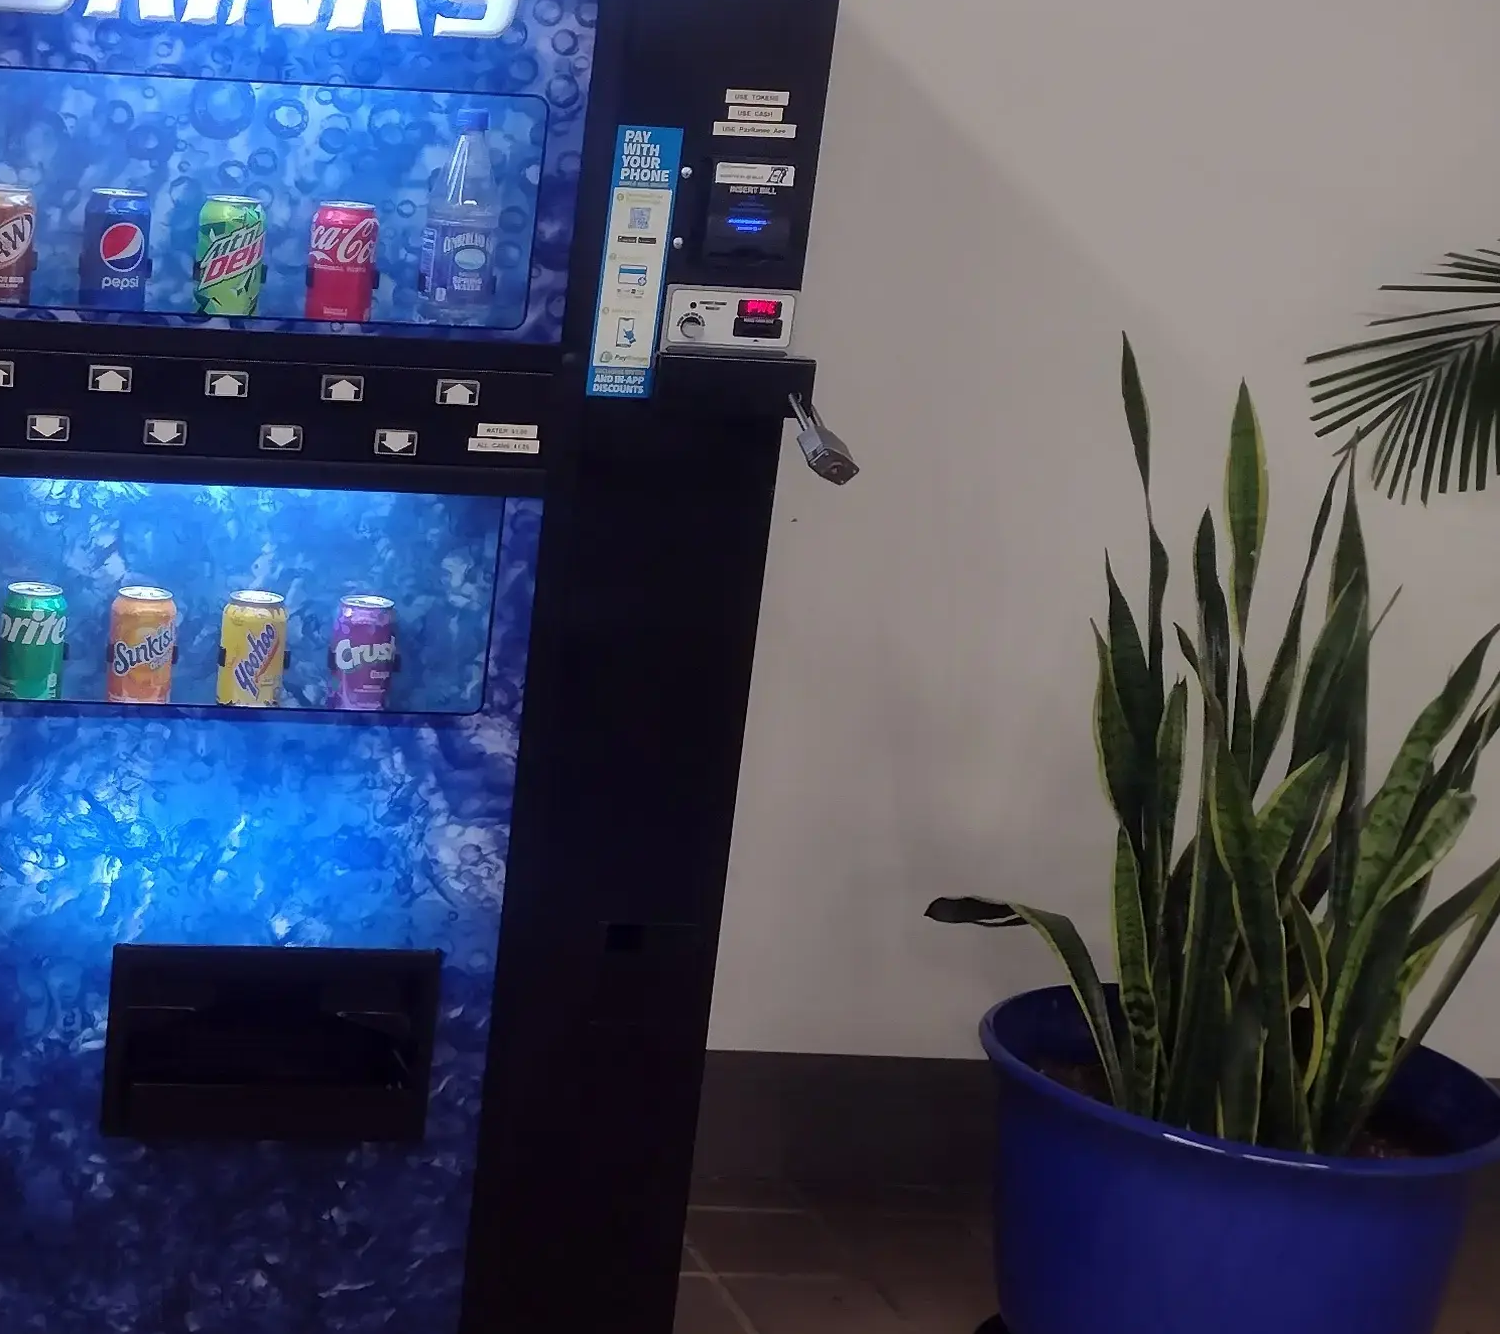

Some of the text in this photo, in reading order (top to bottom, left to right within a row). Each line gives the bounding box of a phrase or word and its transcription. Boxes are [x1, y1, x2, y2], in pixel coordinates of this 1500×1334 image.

[625, 130, 652, 143] PAY
[623, 142, 660, 157] WITH
[621, 155, 660, 169] YOUR
[620, 168, 670, 182] PHONE
[729, 186, 759, 194] INSERT
[101, 275, 140, 291] pepsi
[594, 374, 613, 383] AND
[592, 383, 644, 394] DISCOUNTS
